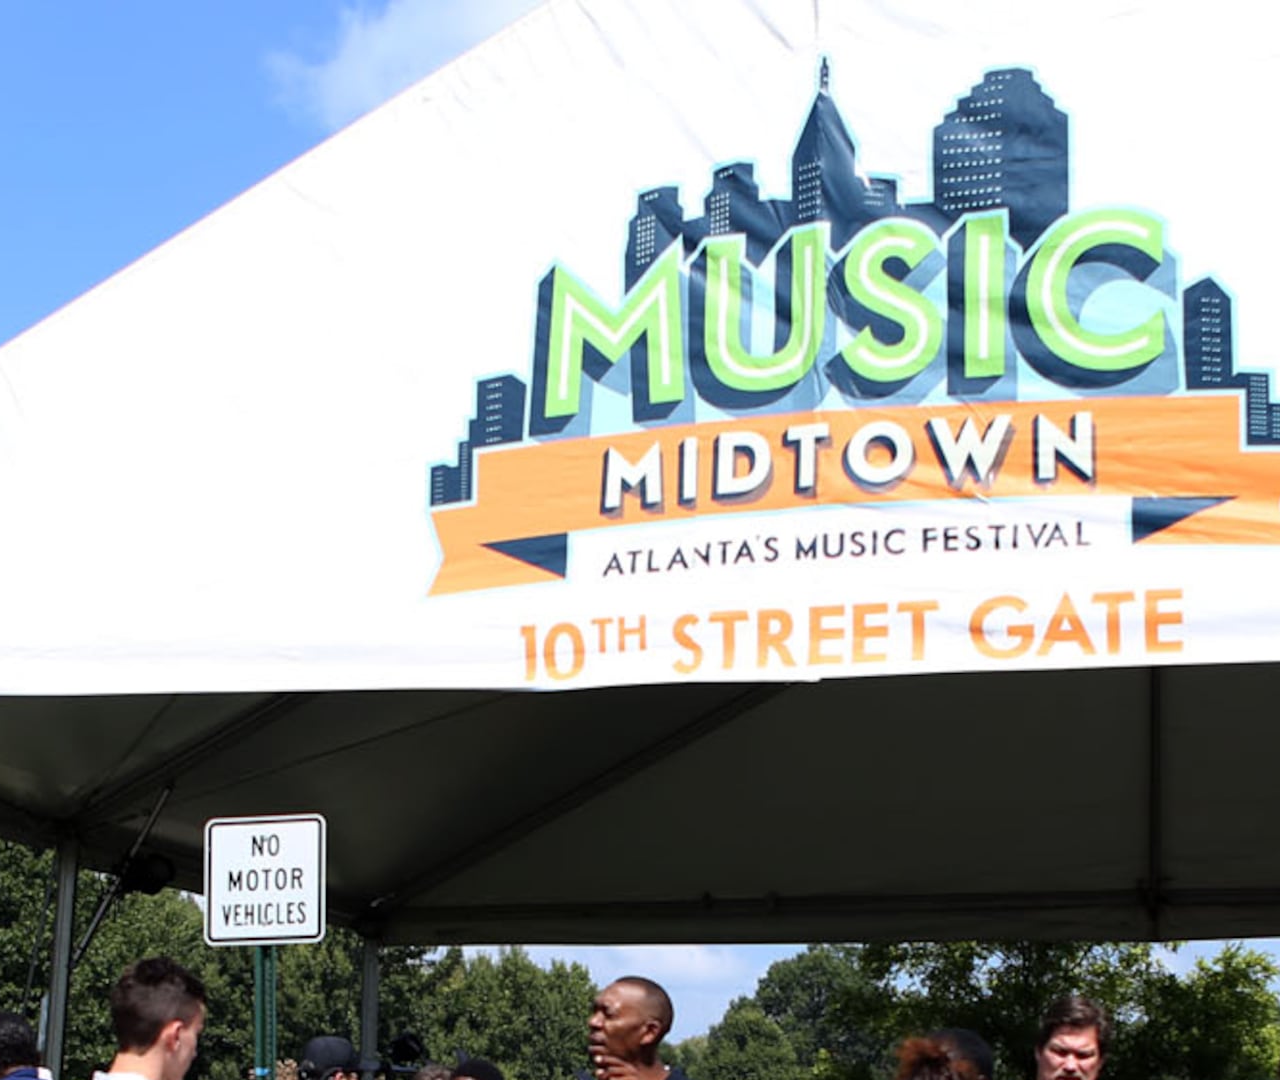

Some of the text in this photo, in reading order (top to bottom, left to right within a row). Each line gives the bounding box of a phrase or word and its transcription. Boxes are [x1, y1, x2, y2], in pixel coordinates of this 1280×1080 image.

[532, 207, 1169, 430] MUSIC
[600, 411, 1097, 517] MIDTOWN
[602, 520, 1092, 577] ATLANTA'S MUSIC FESTIVAL
[520, 589, 1183, 682] 10TH STREET GATE
[251, 834, 280, 857] NO
[228, 867, 303, 892] MOTOR
[222, 901, 307, 926] VEHICLES
